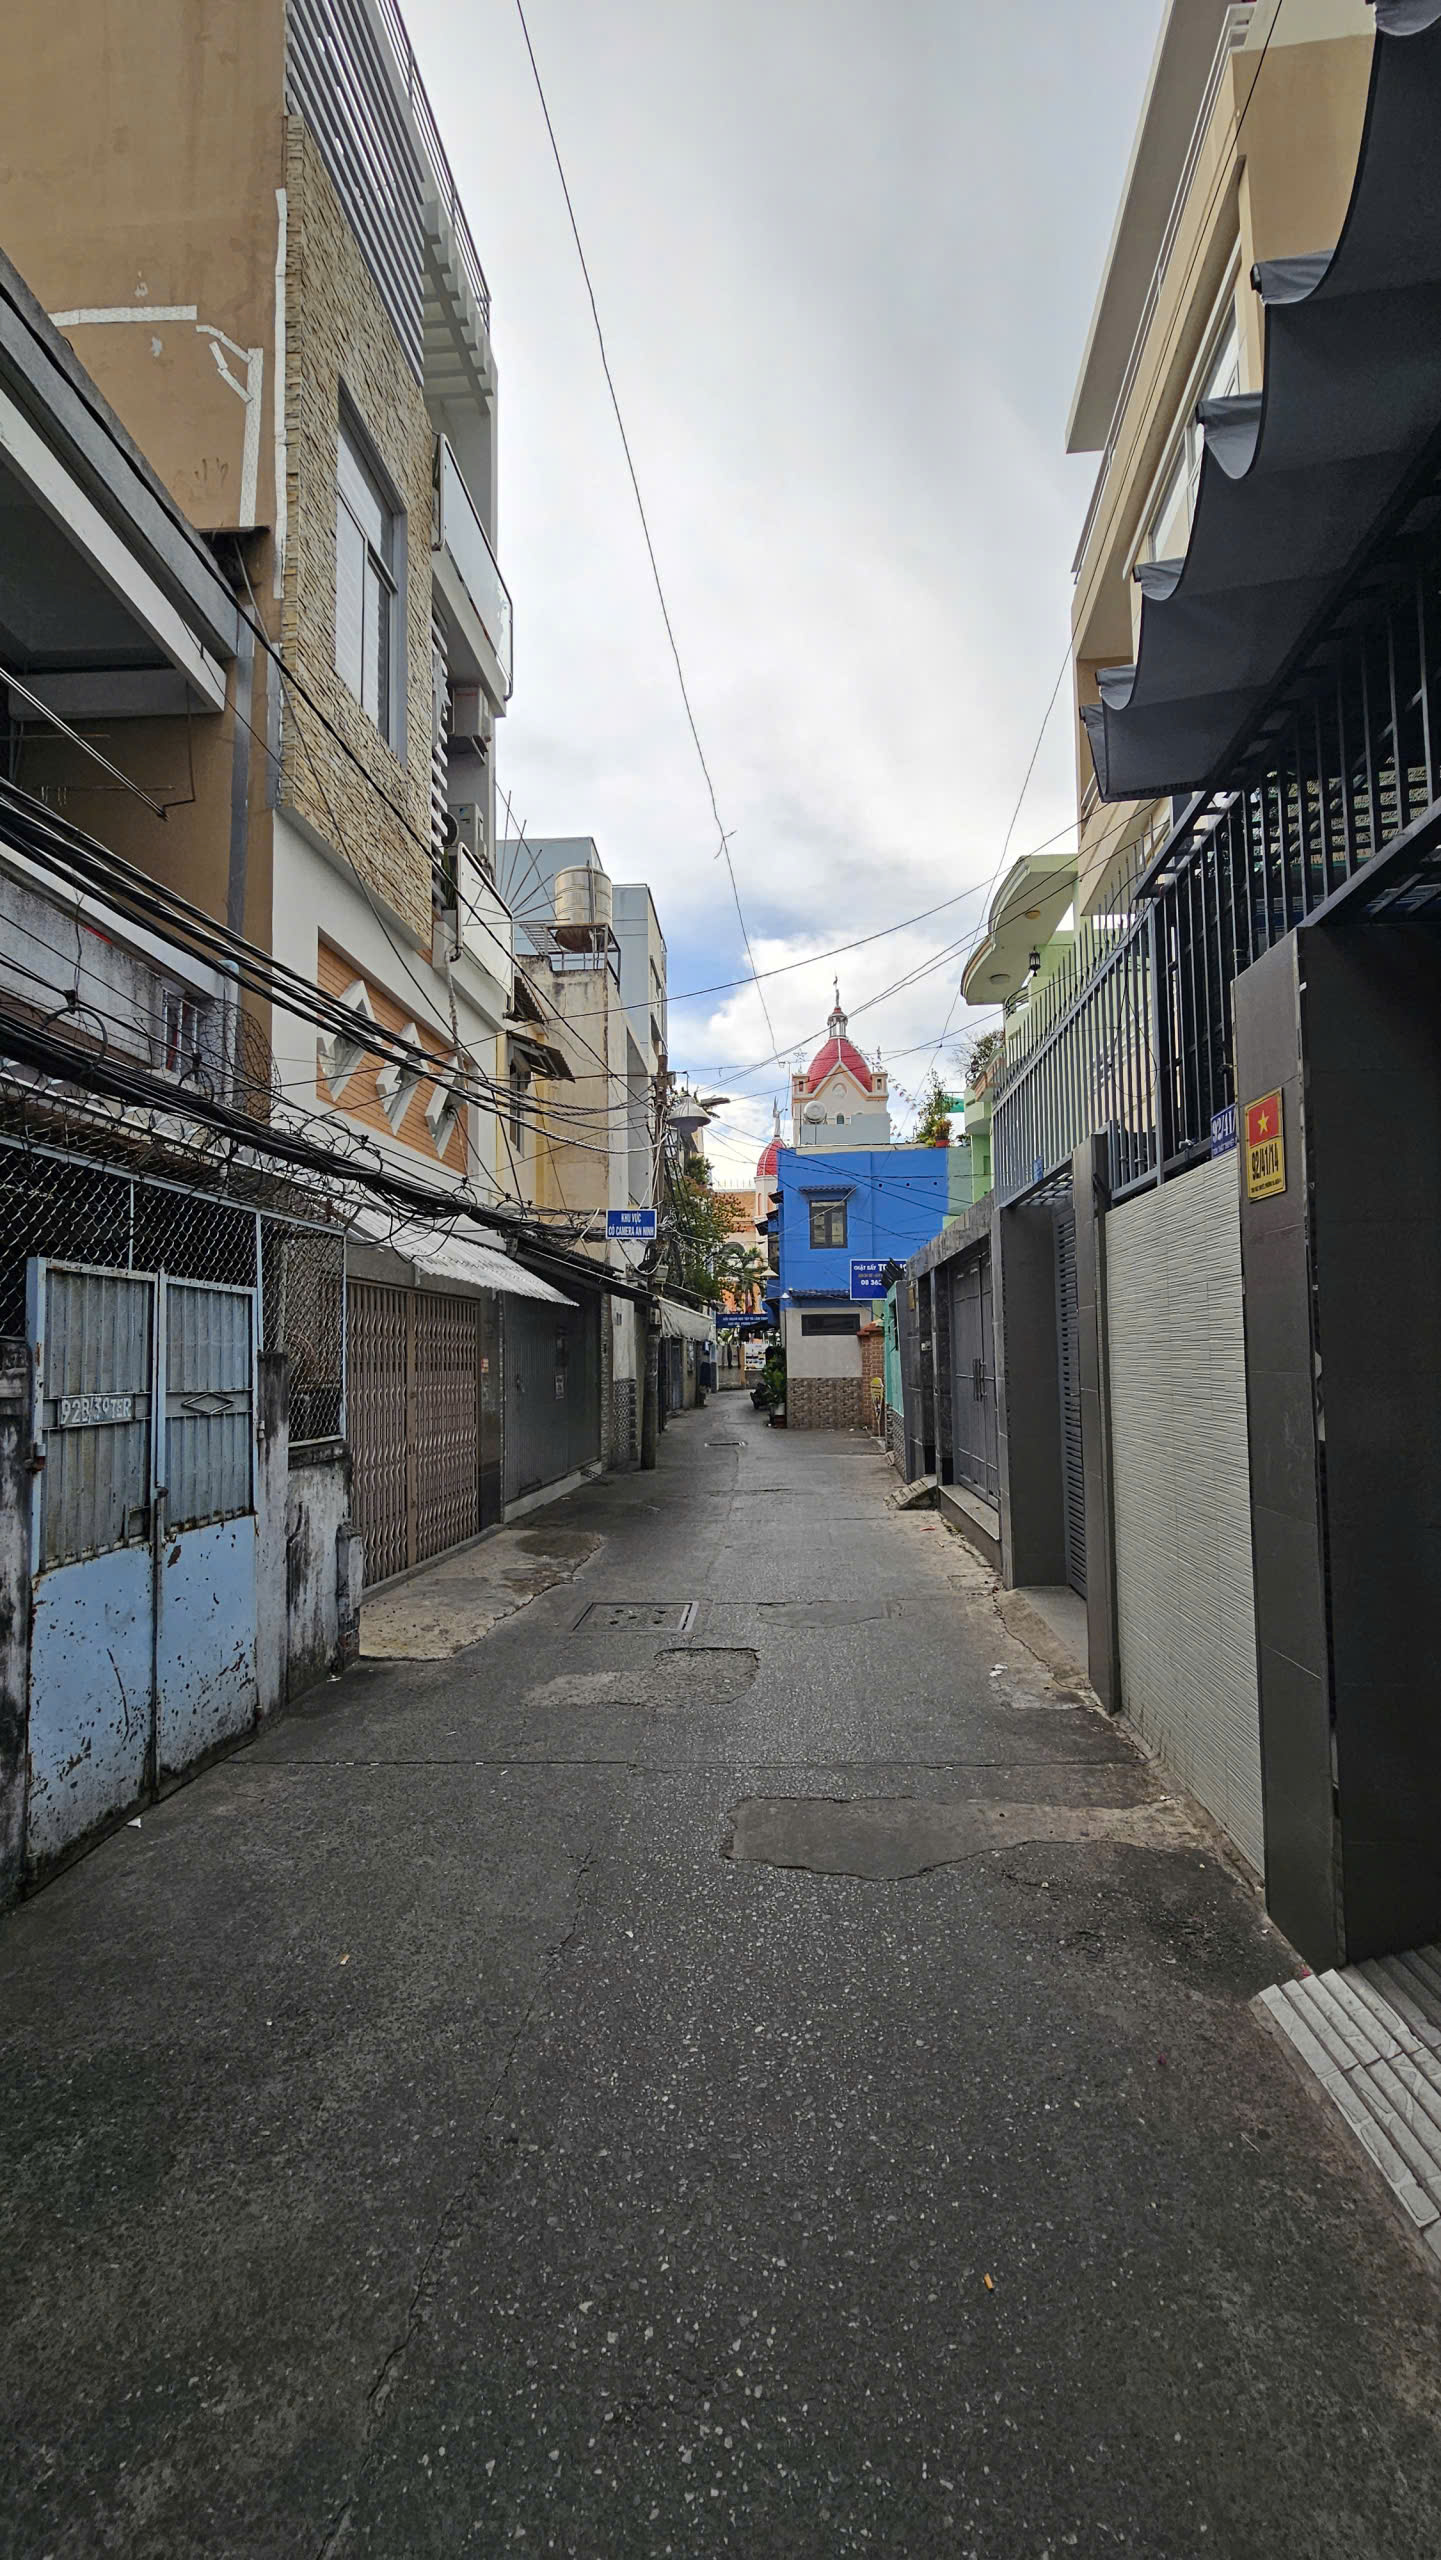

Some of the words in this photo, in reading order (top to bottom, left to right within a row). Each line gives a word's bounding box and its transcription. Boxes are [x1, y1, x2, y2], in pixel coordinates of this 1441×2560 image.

[1252, 1143, 1278, 1180] 92/41/14
[616, 1226, 634, 1235] CAMERA
[635, 1226, 642, 1235] AN
[643, 1226, 653, 1236] NINH
